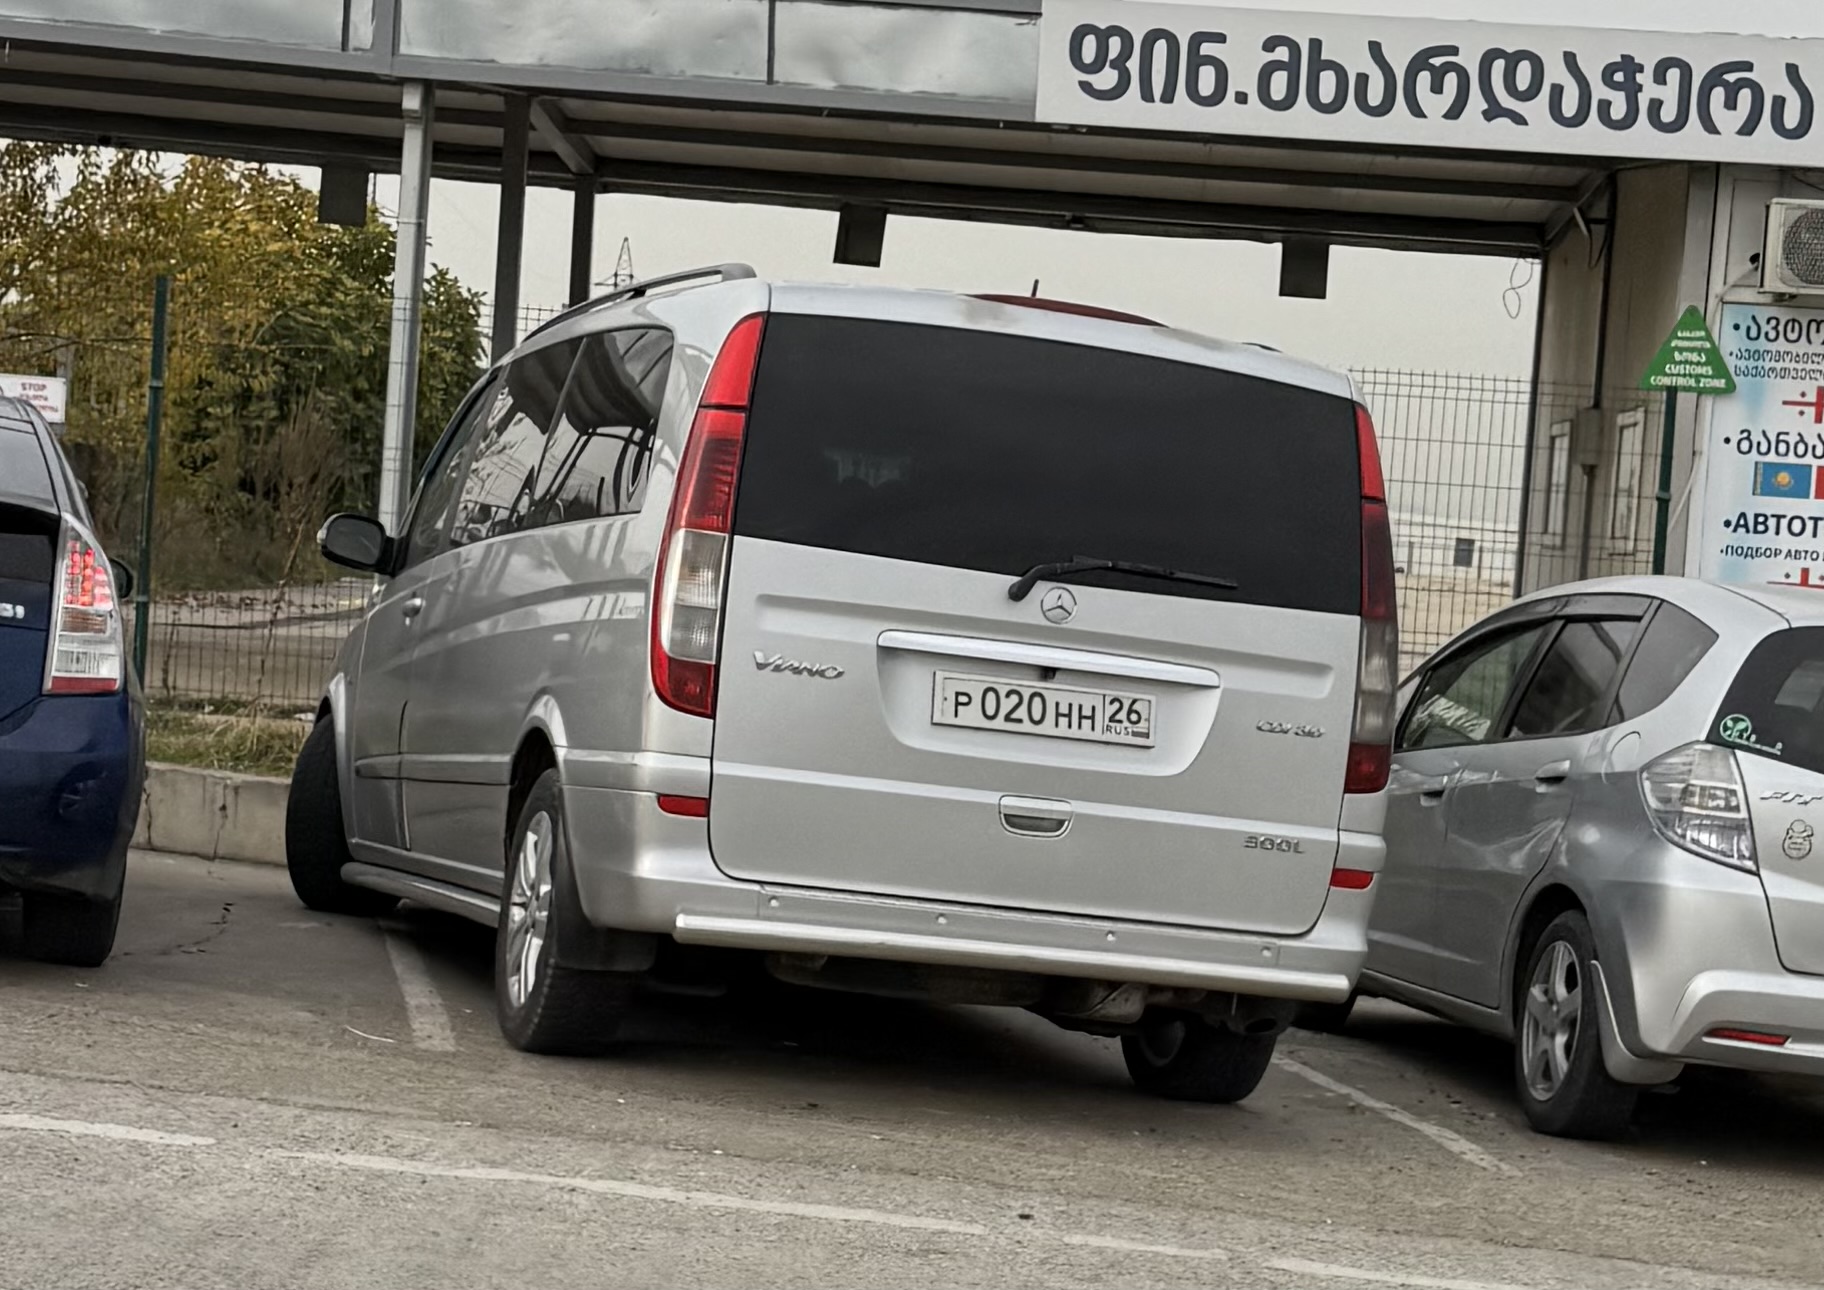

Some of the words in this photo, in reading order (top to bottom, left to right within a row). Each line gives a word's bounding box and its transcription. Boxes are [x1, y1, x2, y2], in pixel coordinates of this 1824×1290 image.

[1665, 363, 1713, 376] CUSTOMS
[21, 382, 47, 392] STOP
[1650, 376, 1697, 387] CONTROL
[1699, 378, 1726, 388] ZONE
[1725, 544, 1783, 560] ПОДБОР
[1784, 549, 1820, 562] АВТО
[1105, 724, 1130, 737] RUS
